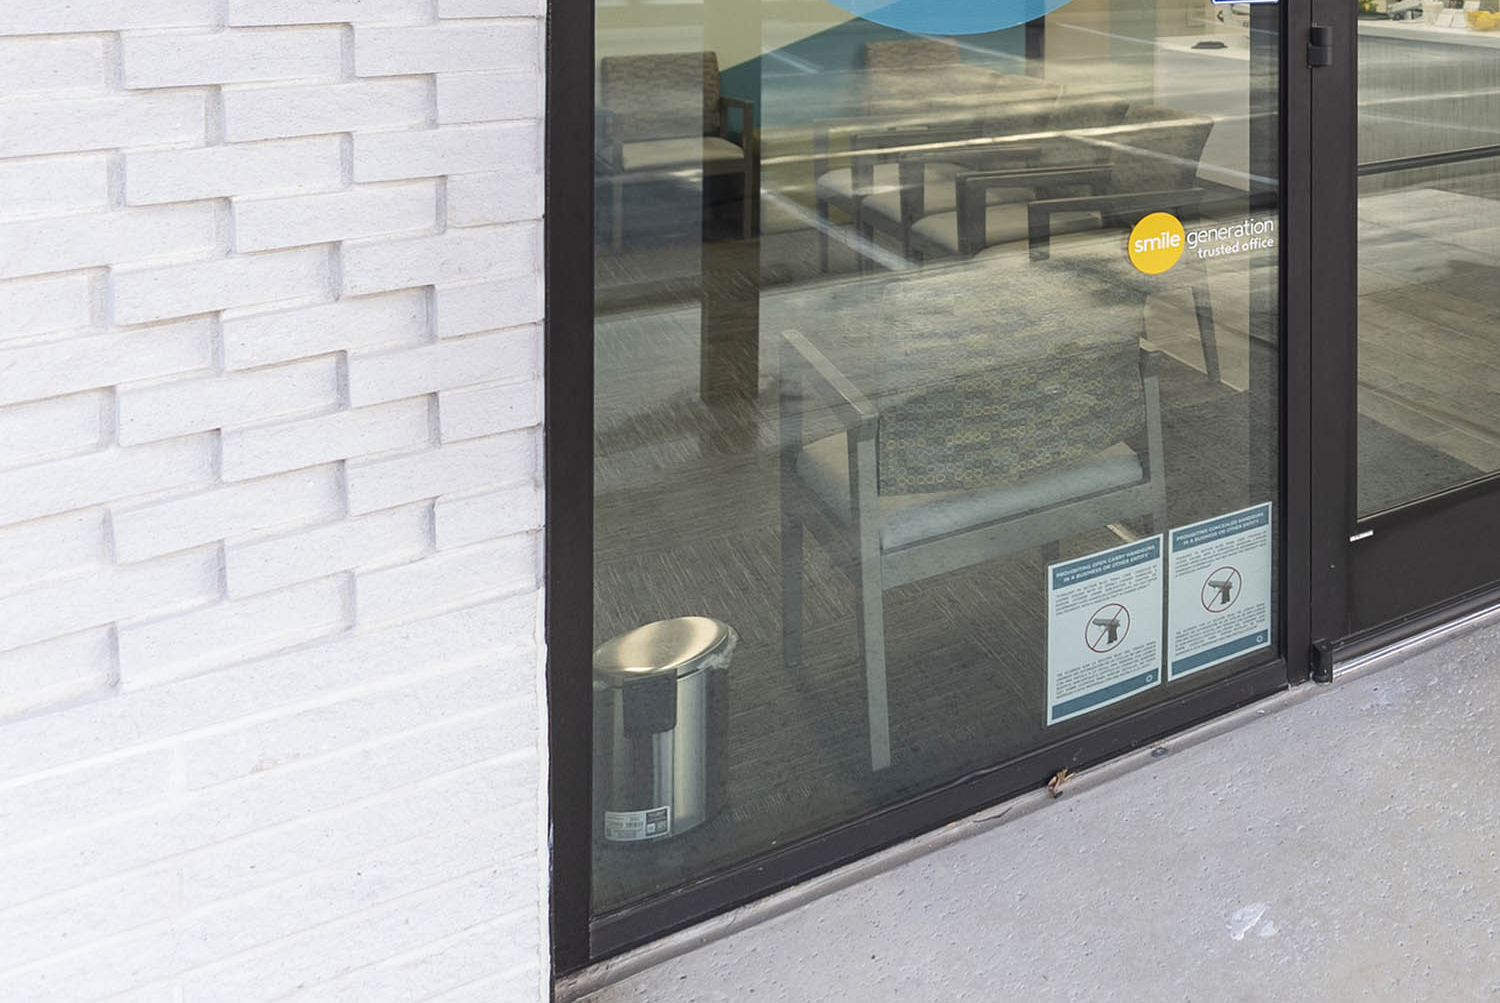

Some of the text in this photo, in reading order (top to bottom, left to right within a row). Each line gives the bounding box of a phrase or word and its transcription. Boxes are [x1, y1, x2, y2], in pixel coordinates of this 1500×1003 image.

[1134, 218, 1274, 253] smile generation
[1197, 237, 1275, 258] trusted office
